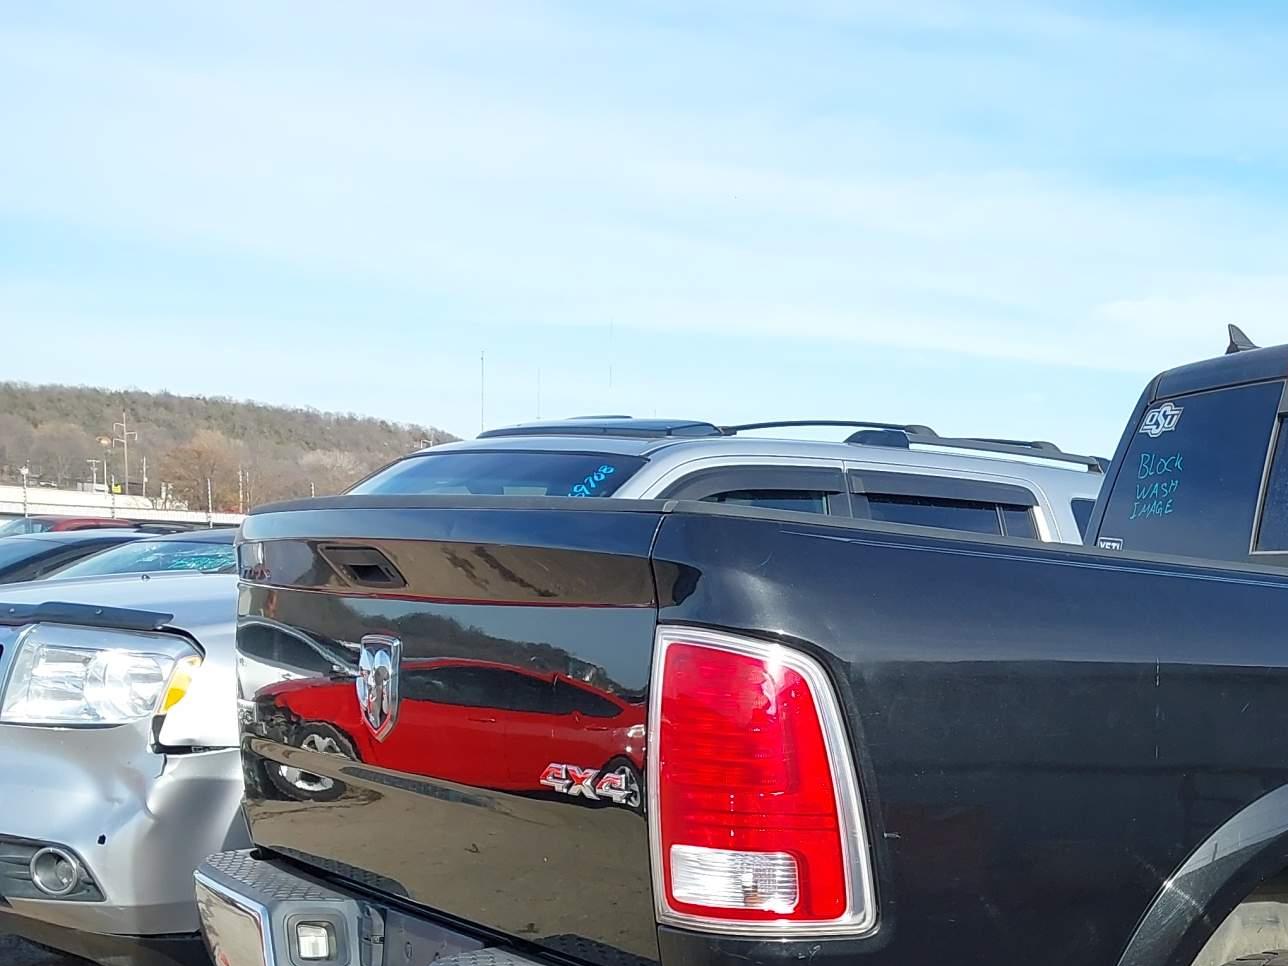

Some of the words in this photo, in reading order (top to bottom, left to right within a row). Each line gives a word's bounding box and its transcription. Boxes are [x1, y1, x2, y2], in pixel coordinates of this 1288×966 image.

[1139, 402, 1184, 437] OSU
[1137, 453, 1184, 479] BLOCK
[1136, 480, 1179, 500] WASH
[1129, 500, 1174, 519] IMAGE
